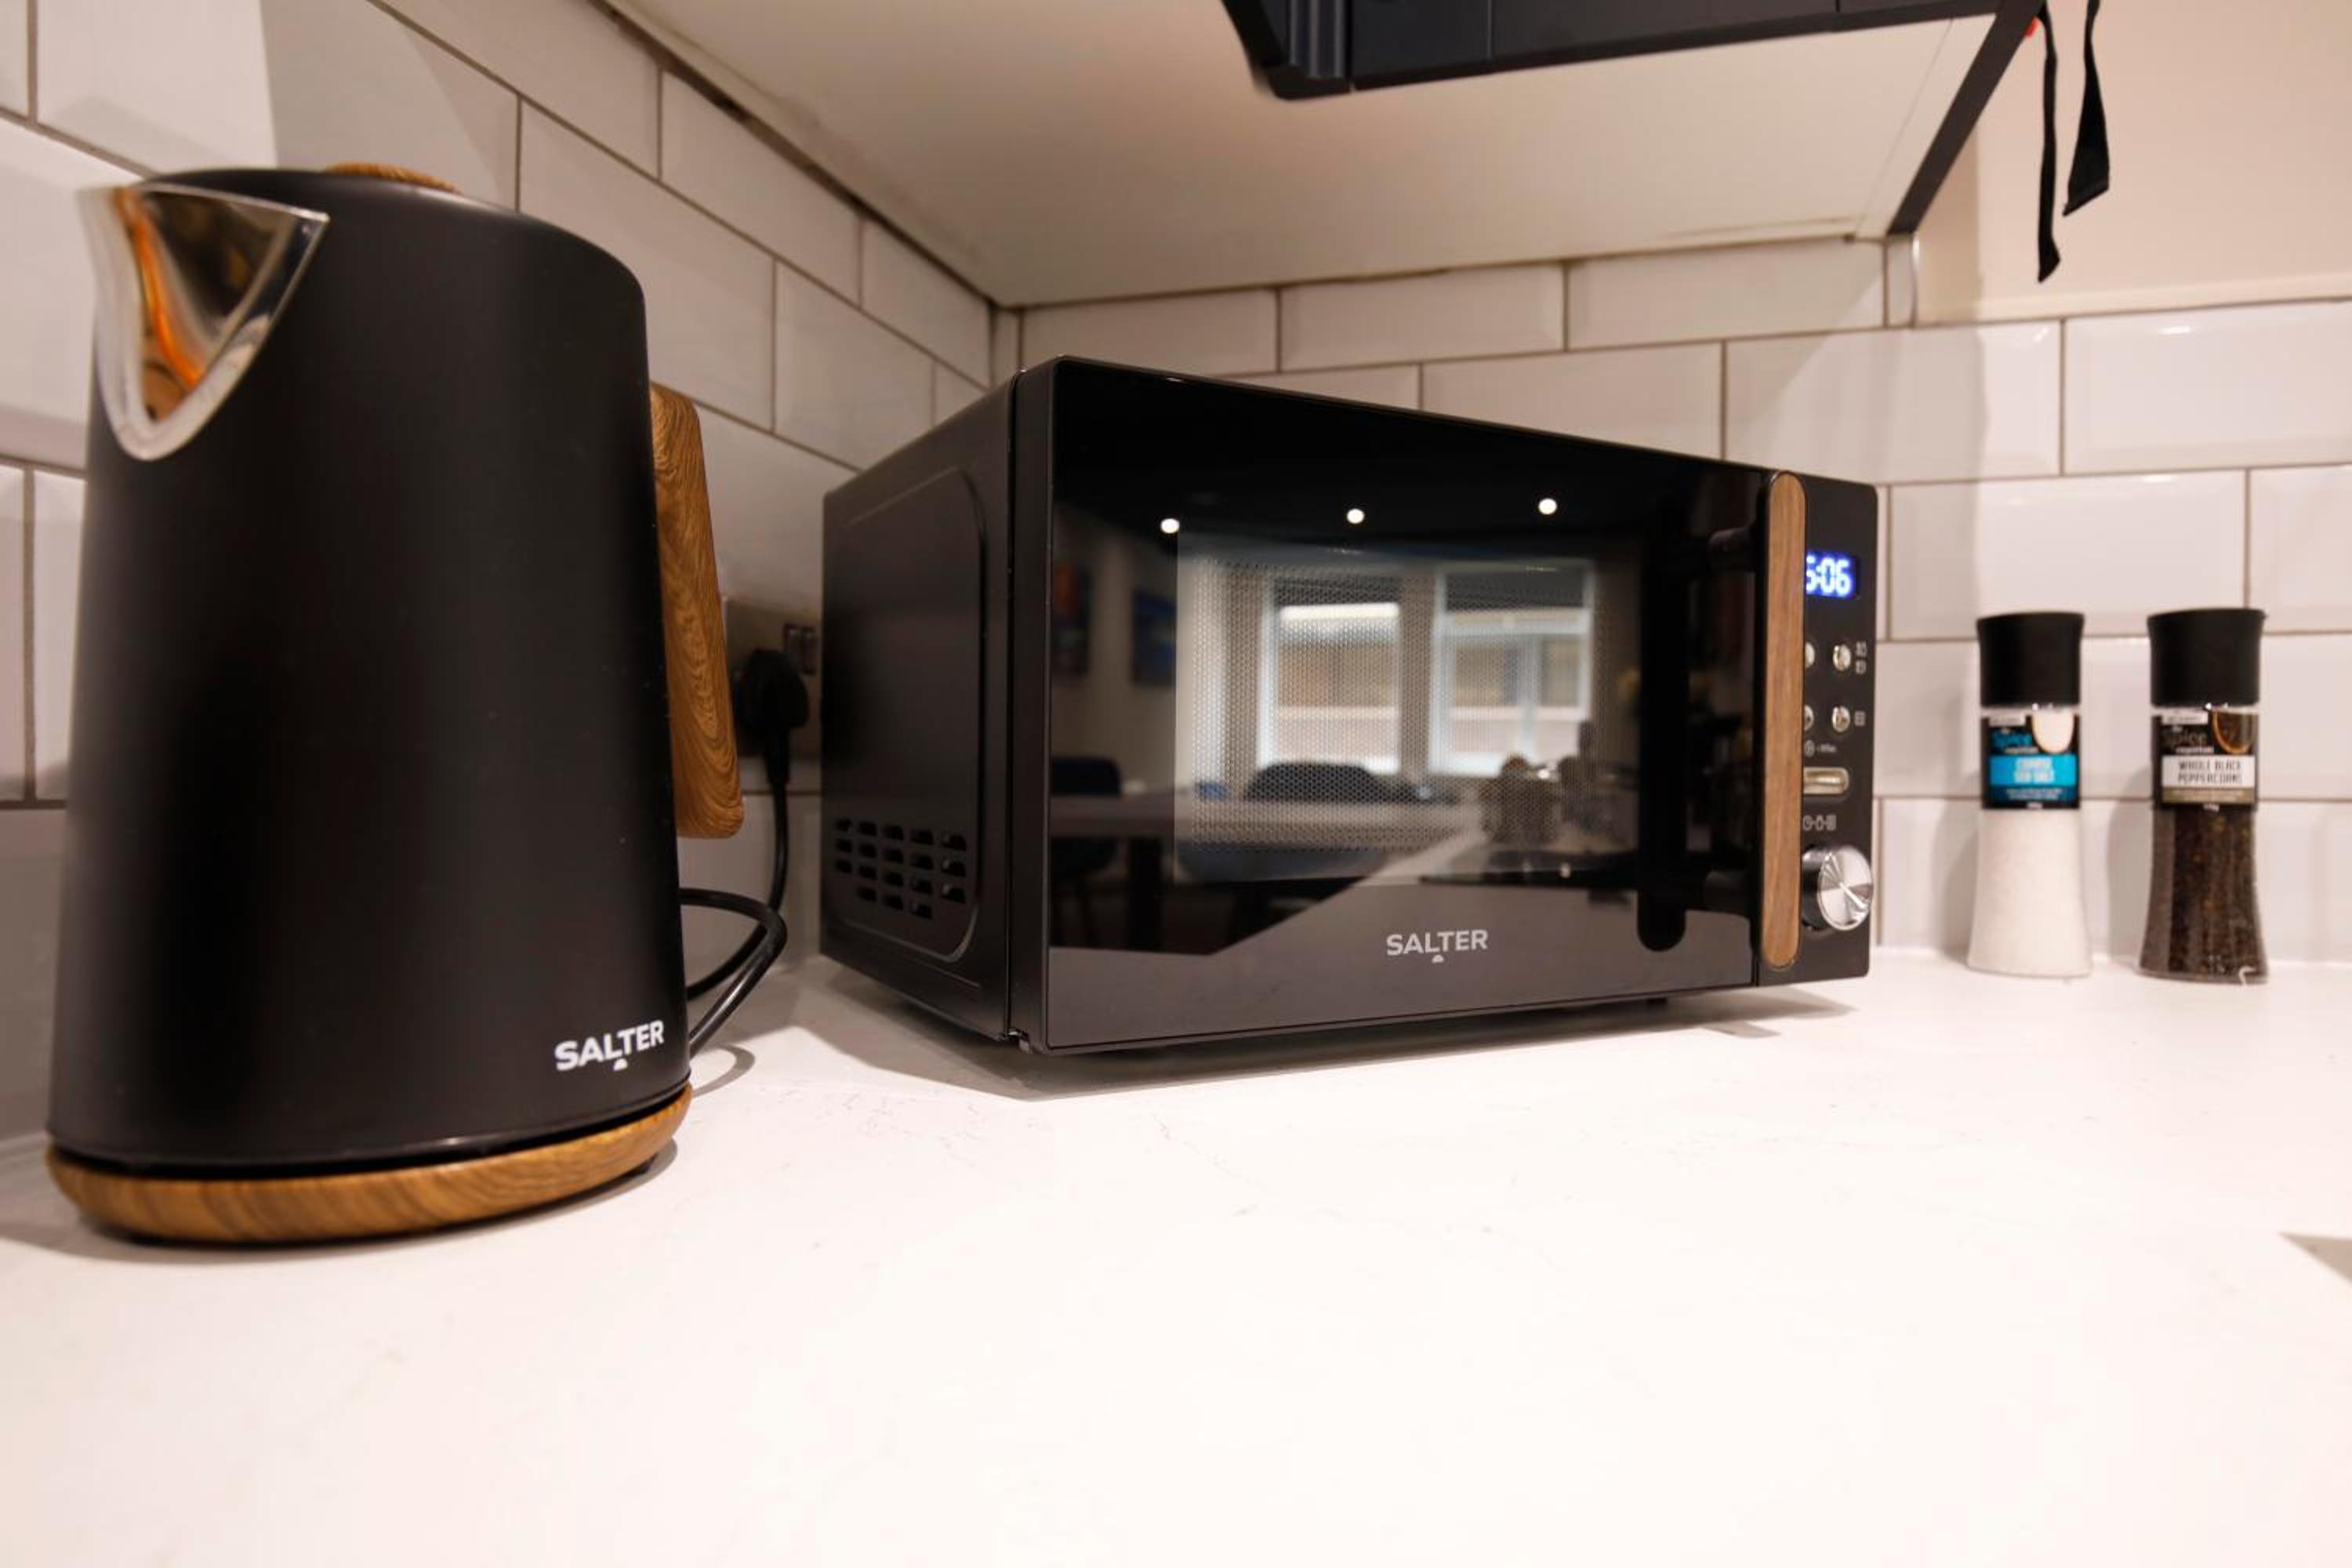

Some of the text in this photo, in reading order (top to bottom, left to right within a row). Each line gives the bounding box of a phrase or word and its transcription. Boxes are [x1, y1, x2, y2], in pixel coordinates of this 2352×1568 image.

[2179, 760, 2241, 771] WHOLE BLACK
[1385, 929, 1488, 956] SALTER
[554, 1019, 665, 1071] SALTER
